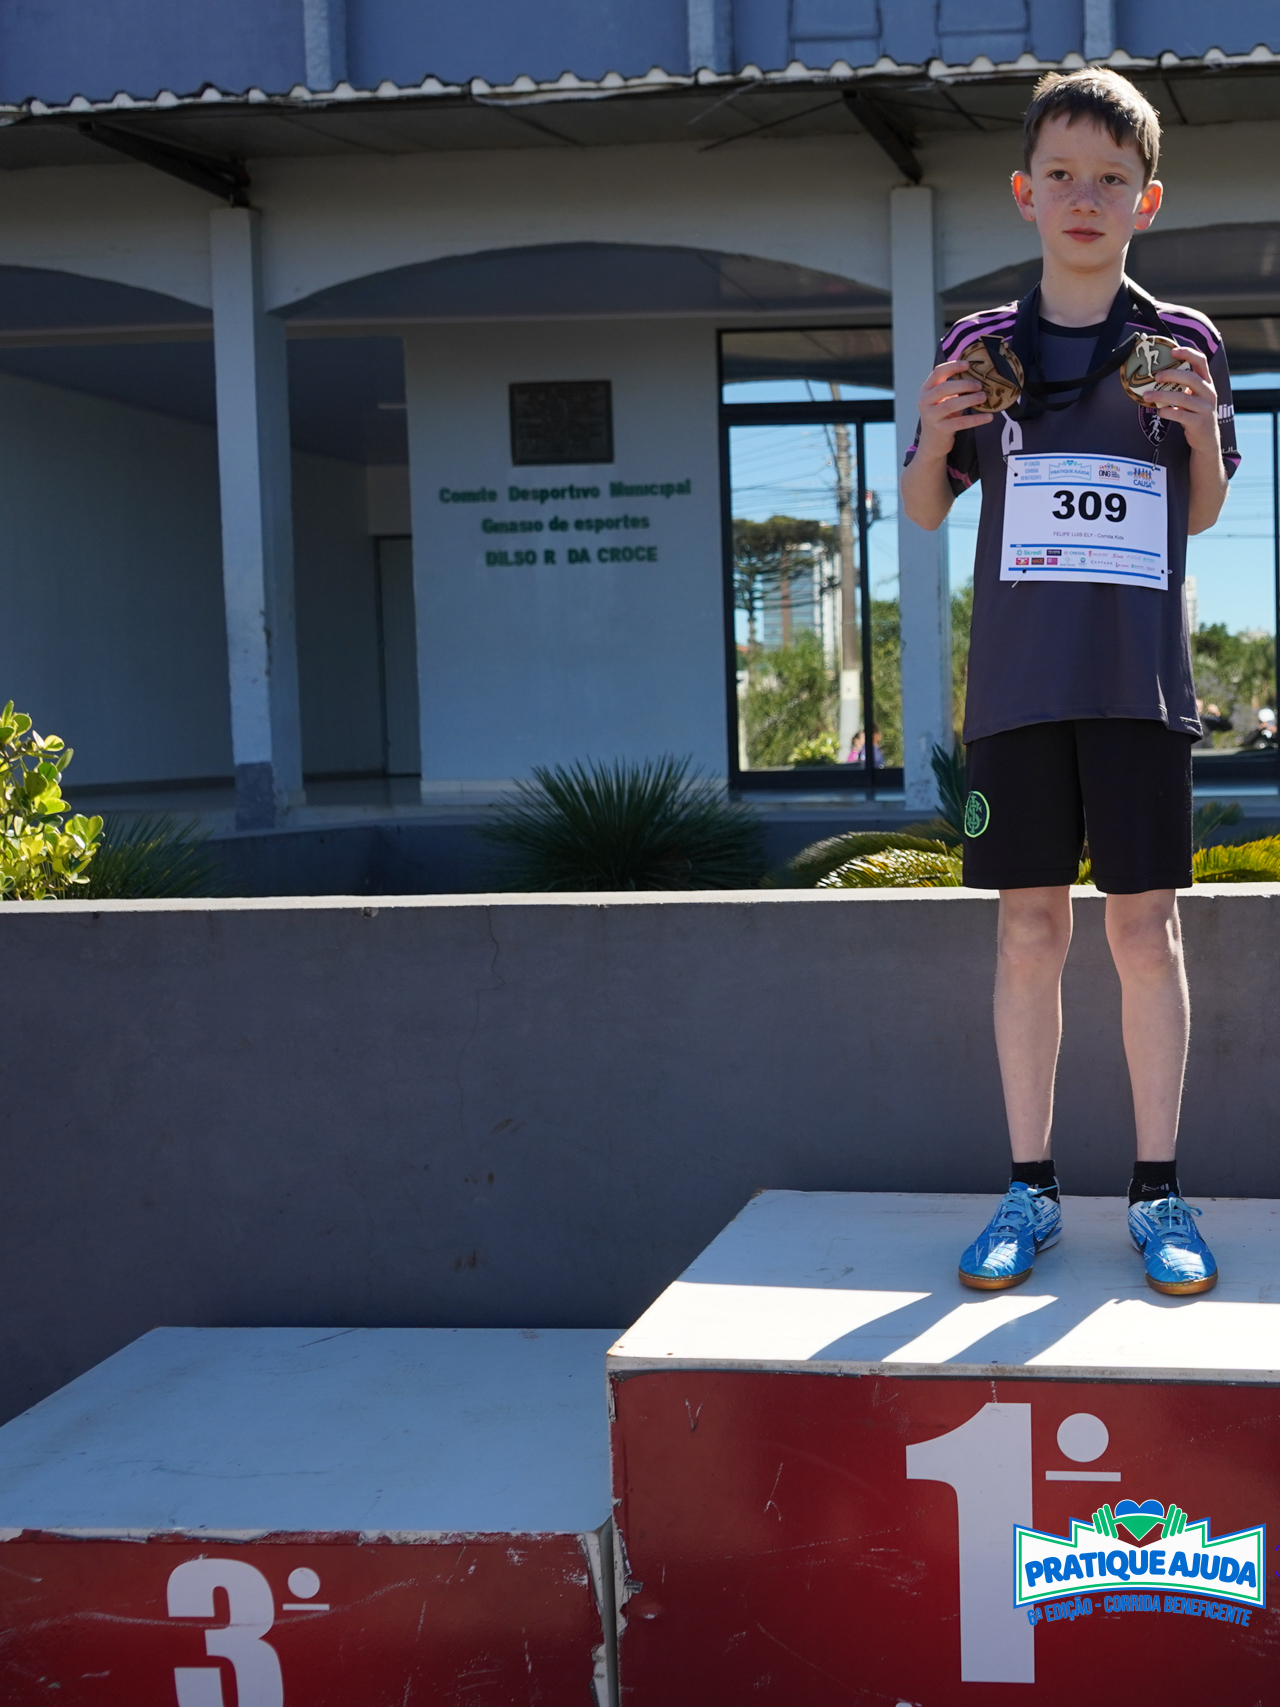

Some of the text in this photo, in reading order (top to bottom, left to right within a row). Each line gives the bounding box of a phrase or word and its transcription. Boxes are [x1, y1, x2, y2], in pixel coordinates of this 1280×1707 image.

[508, 484, 601, 504] Desportivo
[610, 478, 691, 499] Municipal
[1052, 490, 1127, 523] 309
[549, 514, 569, 532] de
[574, 514, 650, 534] esportes
[485, 546, 658, 567] DILSO R DA CROCE
